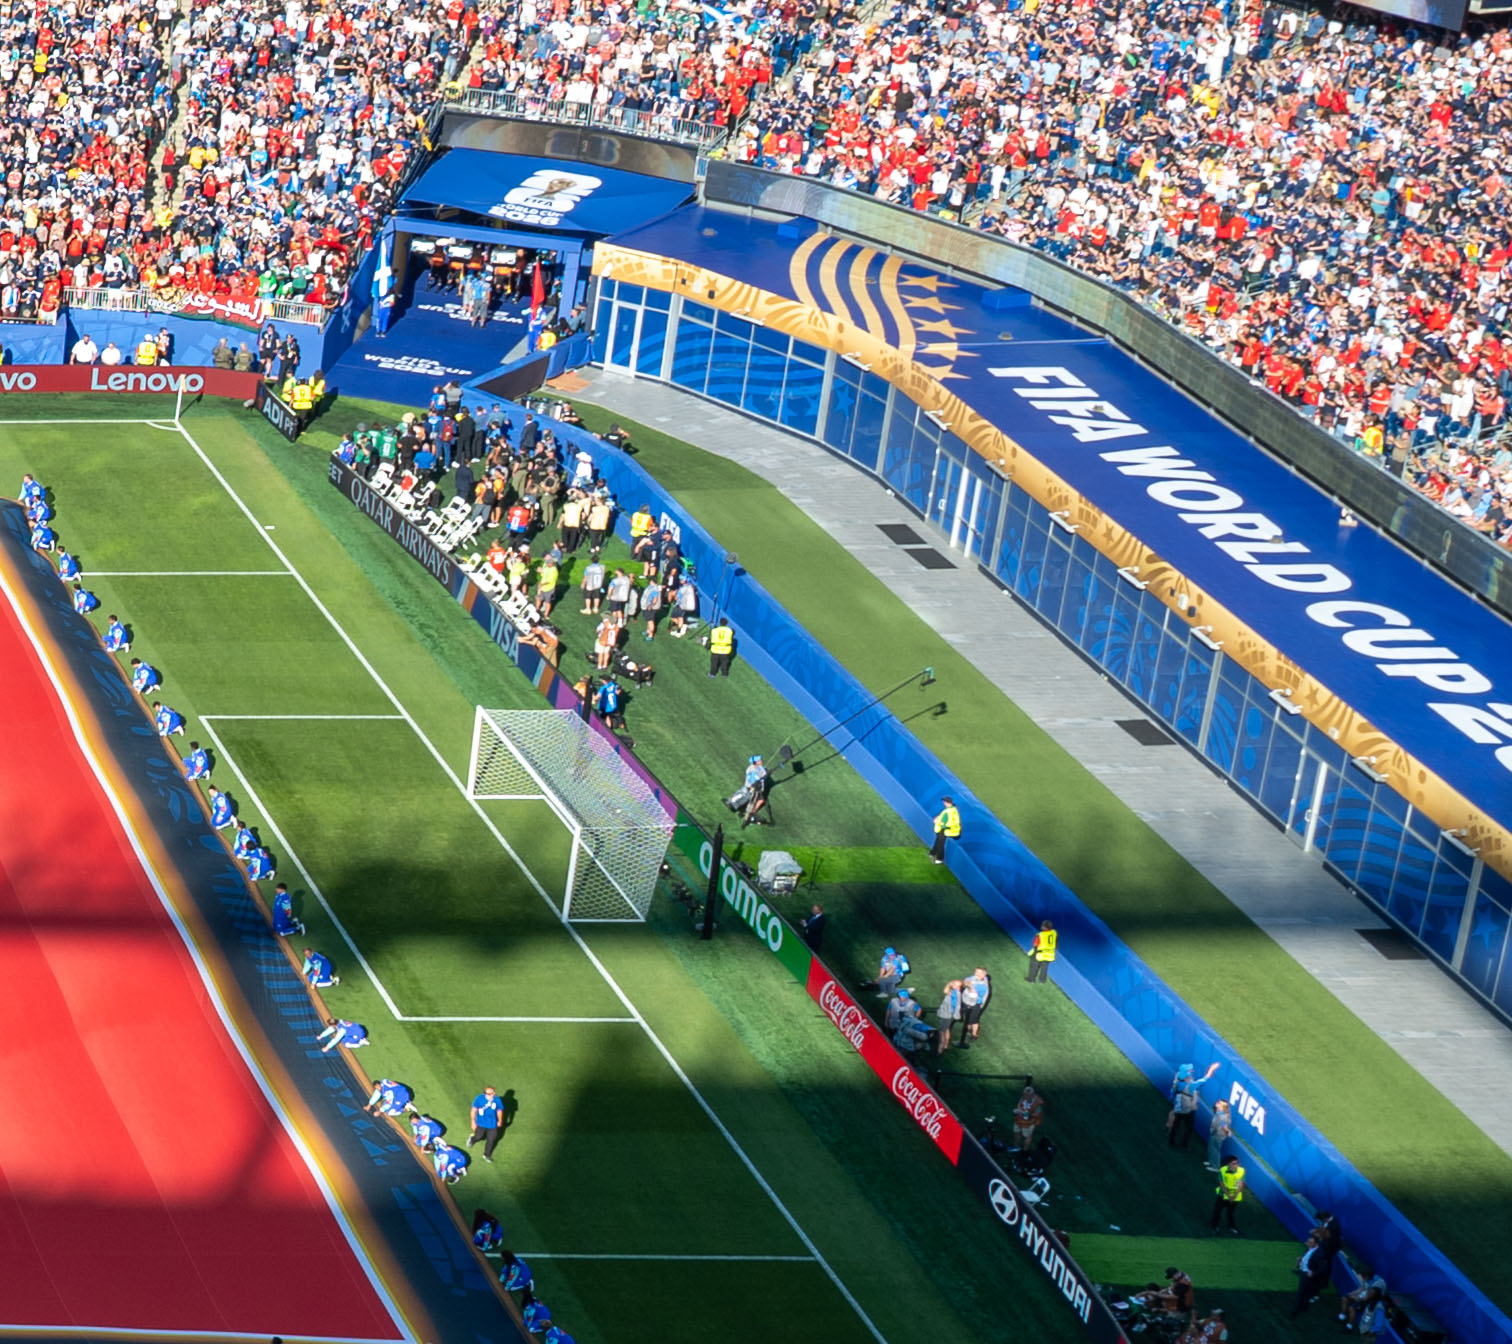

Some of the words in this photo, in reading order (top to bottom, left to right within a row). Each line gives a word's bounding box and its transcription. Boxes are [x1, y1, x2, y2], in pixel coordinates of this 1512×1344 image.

[488, 206, 562, 226] 2026
[90, 367, 204, 393] Lenovo
[262, 396, 284, 429] ADI
[350, 477, 392, 534] QATAR
[395, 524, 450, 586] AIRWAYS
[659, 511, 681, 544] FIFA
[987, 365, 1149, 443] FIFA
[1099, 445, 1353, 594] WORLD
[1305, 600, 1494, 695] CUP
[487, 602, 520, 665] VISA
[699, 840, 783, 953] aamco
[1229, 1080, 1266, 1136] FIFA
[1019, 1213, 1092, 1324] HYUNDAI
